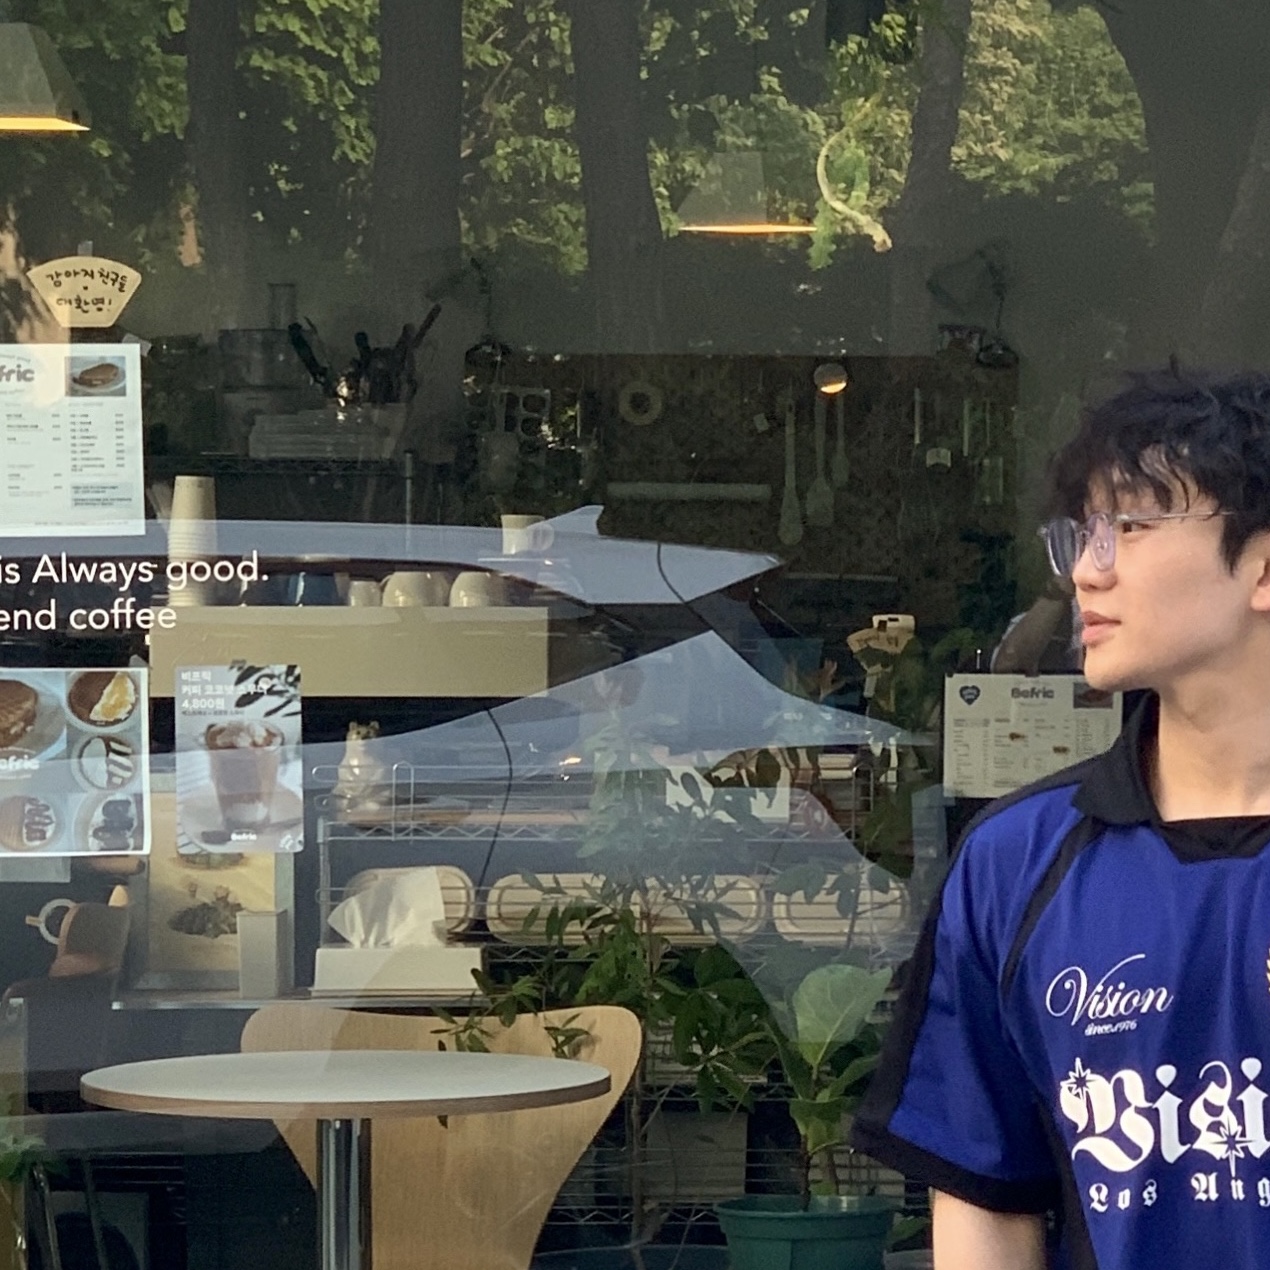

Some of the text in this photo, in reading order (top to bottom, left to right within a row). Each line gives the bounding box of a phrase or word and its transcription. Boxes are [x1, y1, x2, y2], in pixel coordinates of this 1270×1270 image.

[46, 268, 127, 293] 강아지 친구들
[32, 551, 154, 590] Always
[166, 550, 269, 591] good.
[69, 598, 177, 630] coffee
[1011, 687, 1055, 699] Befric
[1045, 953, 1174, 1026] Vision
[1089, 1179, 1158, 1213] Los
